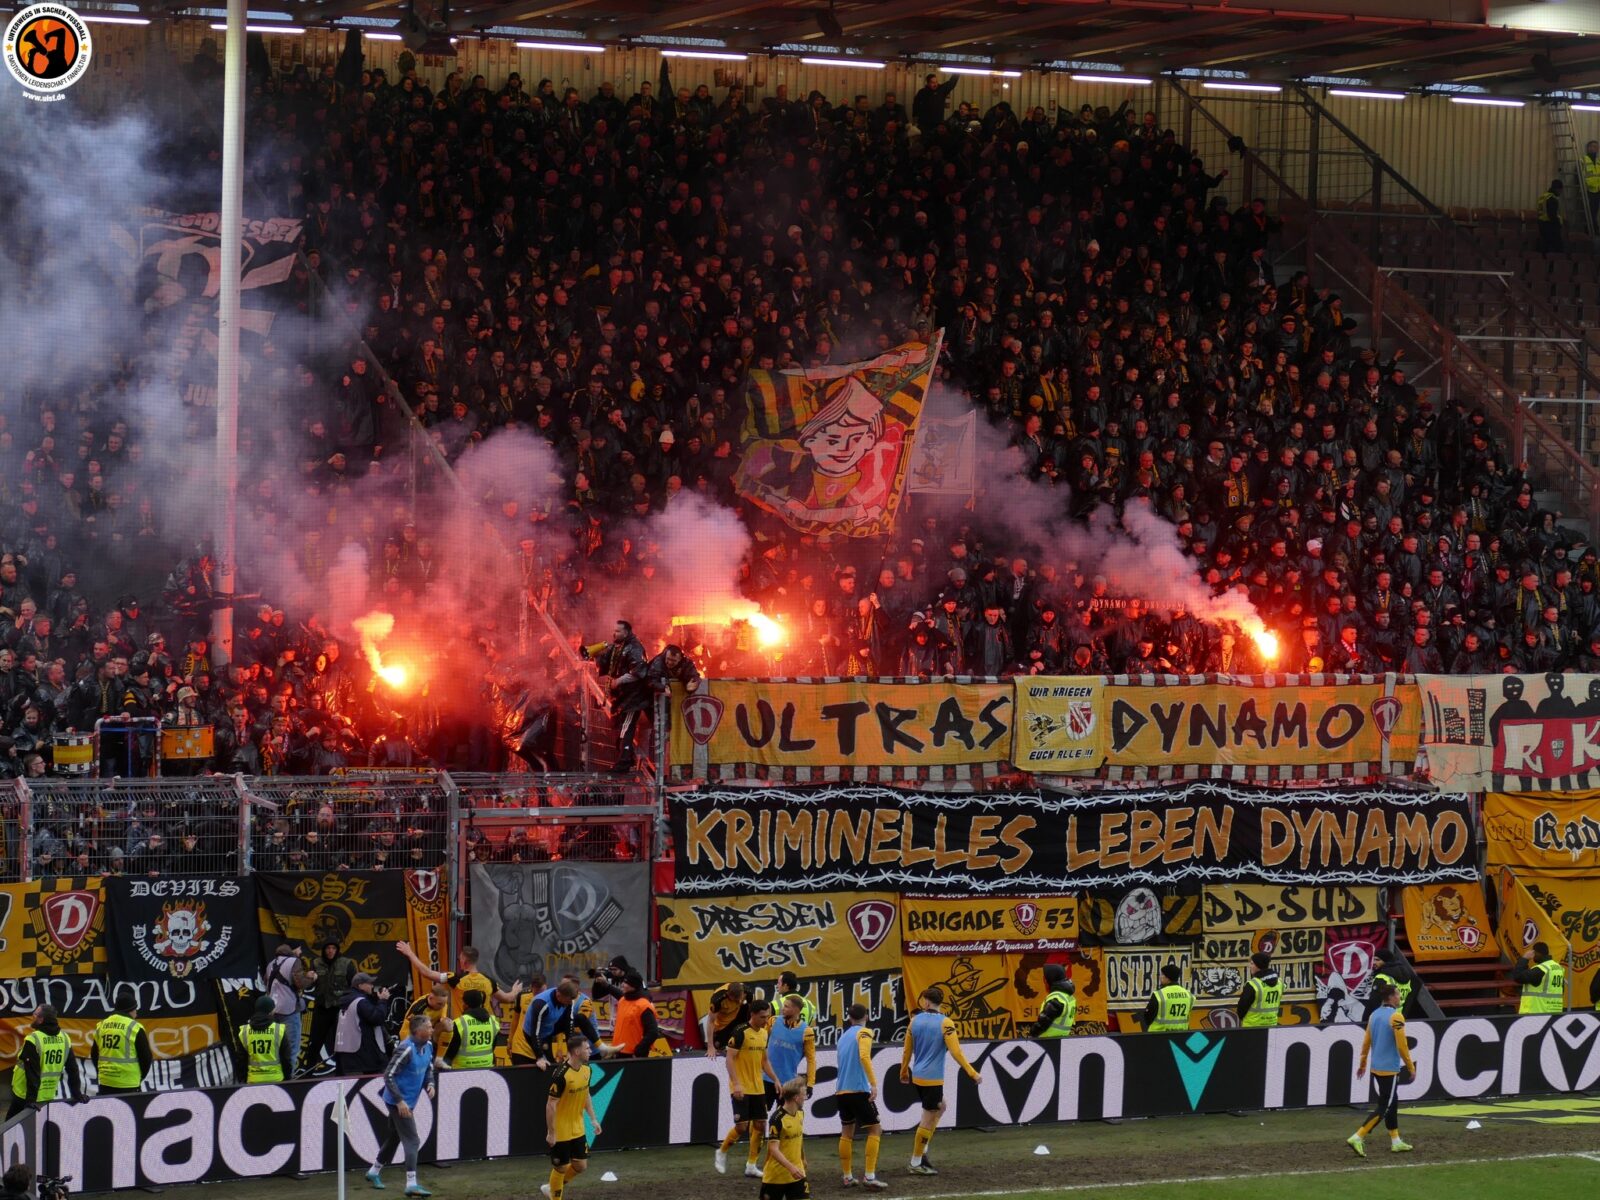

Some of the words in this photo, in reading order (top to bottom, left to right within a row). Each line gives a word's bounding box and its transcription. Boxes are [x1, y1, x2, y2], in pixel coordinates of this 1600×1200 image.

[1029, 687, 1050, 697] WIR
[1052, 687, 1093, 697] KRIEGEN
[735, 697, 1011, 756] ULTRAS
[1110, 698, 1364, 753] DYNAMO
[1029, 750, 1055, 760] EUCH
[1057, 749, 1082, 759] ALLE
[686, 807, 1037, 874] KRIMINELLES
[1065, 804, 1235, 874] LEBEN
[1259, 807, 1468, 870] DYNAMO
[130, 880, 240, 897] DEVILS
[691, 901, 836, 940] DRESDEN
[908, 909, 1005, 931] BRIGADE
[1014, 919, 1040, 936] DRESDEN
[1045, 908, 1074, 930] 53
[38, 930, 98, 964] DRESDEN
[132, 923, 168, 972] Dynamo
[191, 925, 233, 973] Dresden
[909, 940, 992, 954] Sportgemeinschaft
[996, 940, 1034, 952] Dynamo
[1037, 939, 1075, 950] Dresden
[1193, 937, 1250, 959] Forza
[1280, 930, 1323, 954] SGD
[717, 938, 823, 973] WEST
[1107, 954, 1201, 998] OSTBLCK
[1170, 1004, 1187, 1017] 472
[101, 1034, 121, 1049] 152
[251, 1040, 272, 1055] 137
[470, 1031, 492, 1046] 339
[45, 1049, 63, 1064] 166
[36, 1069, 510, 1197] macron
